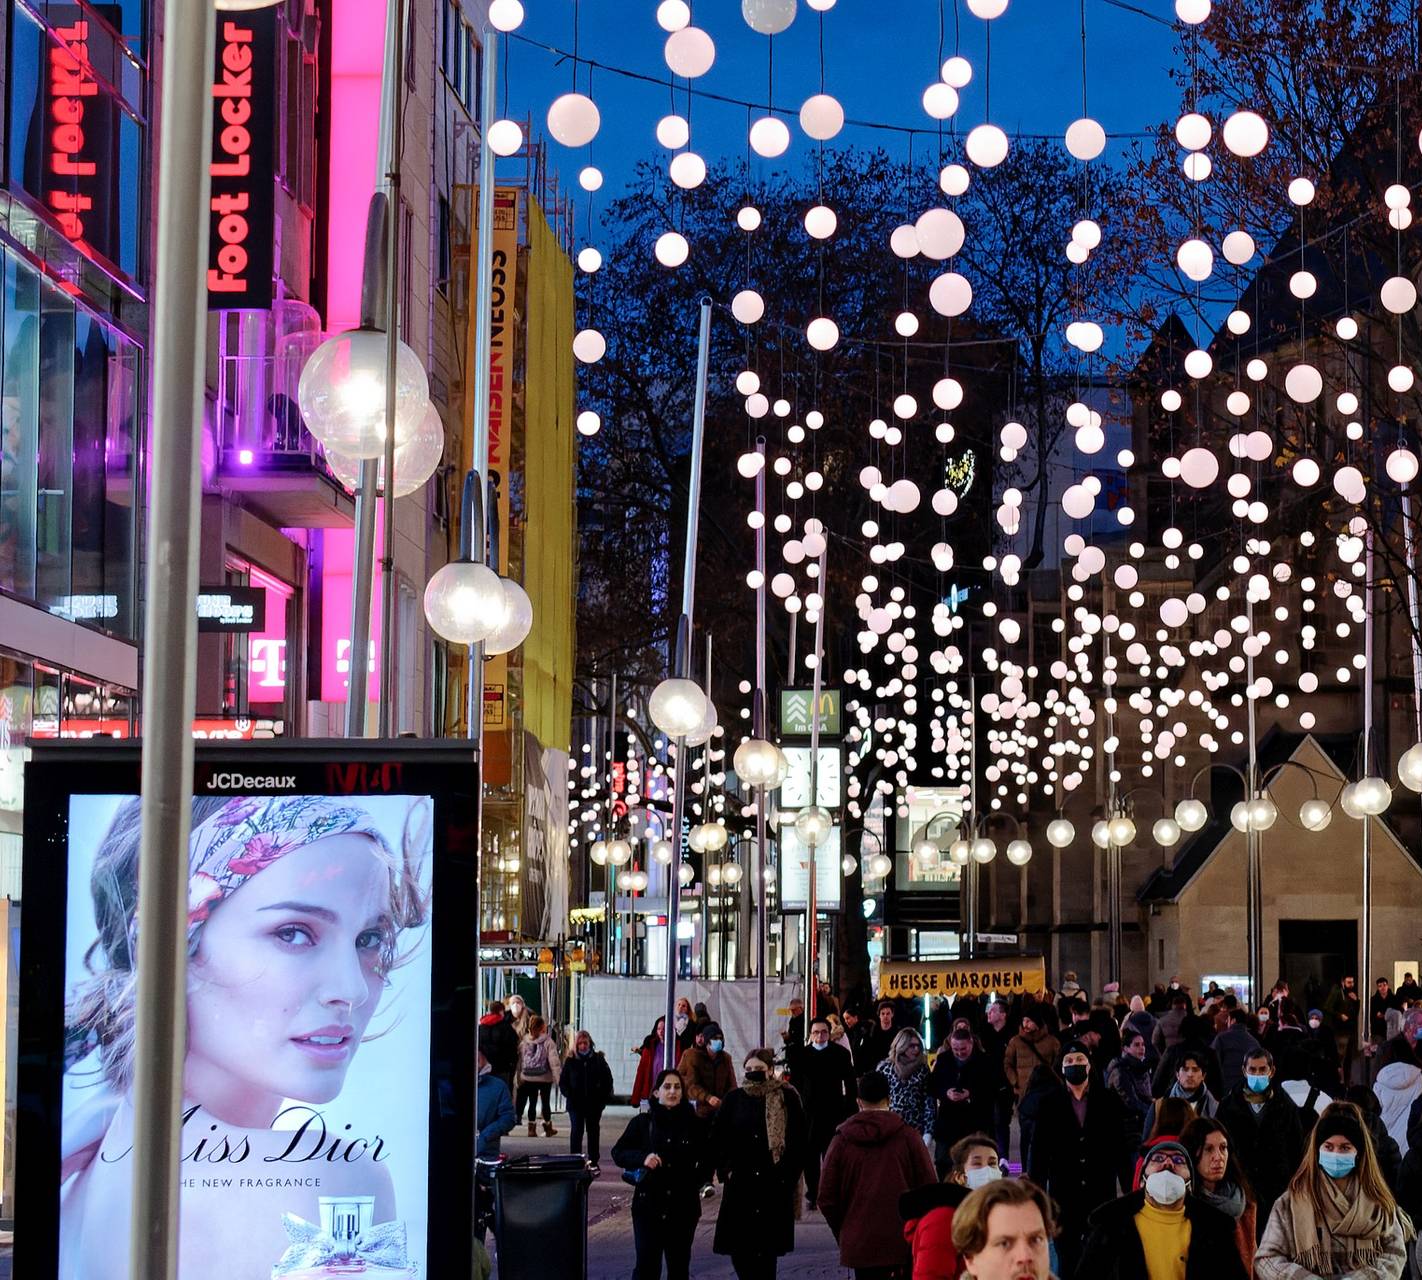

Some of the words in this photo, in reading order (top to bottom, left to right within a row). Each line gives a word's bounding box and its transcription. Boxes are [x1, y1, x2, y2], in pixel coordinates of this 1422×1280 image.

[209, 22, 253, 176] Locker
[208, 192, 249, 292] Foot
[808, 724, 828, 732] CA
[207, 773, 296, 789] JCDecaux
[889, 974, 938, 990] HEISSE
[946, 971, 1023, 989] MARONEN
[264, 1106, 391, 1163] Dior
[180, 1178, 195, 1188] HE
[202, 1178, 232, 1188] NEW
[240, 1178, 321, 1188] FRAGRANCE
